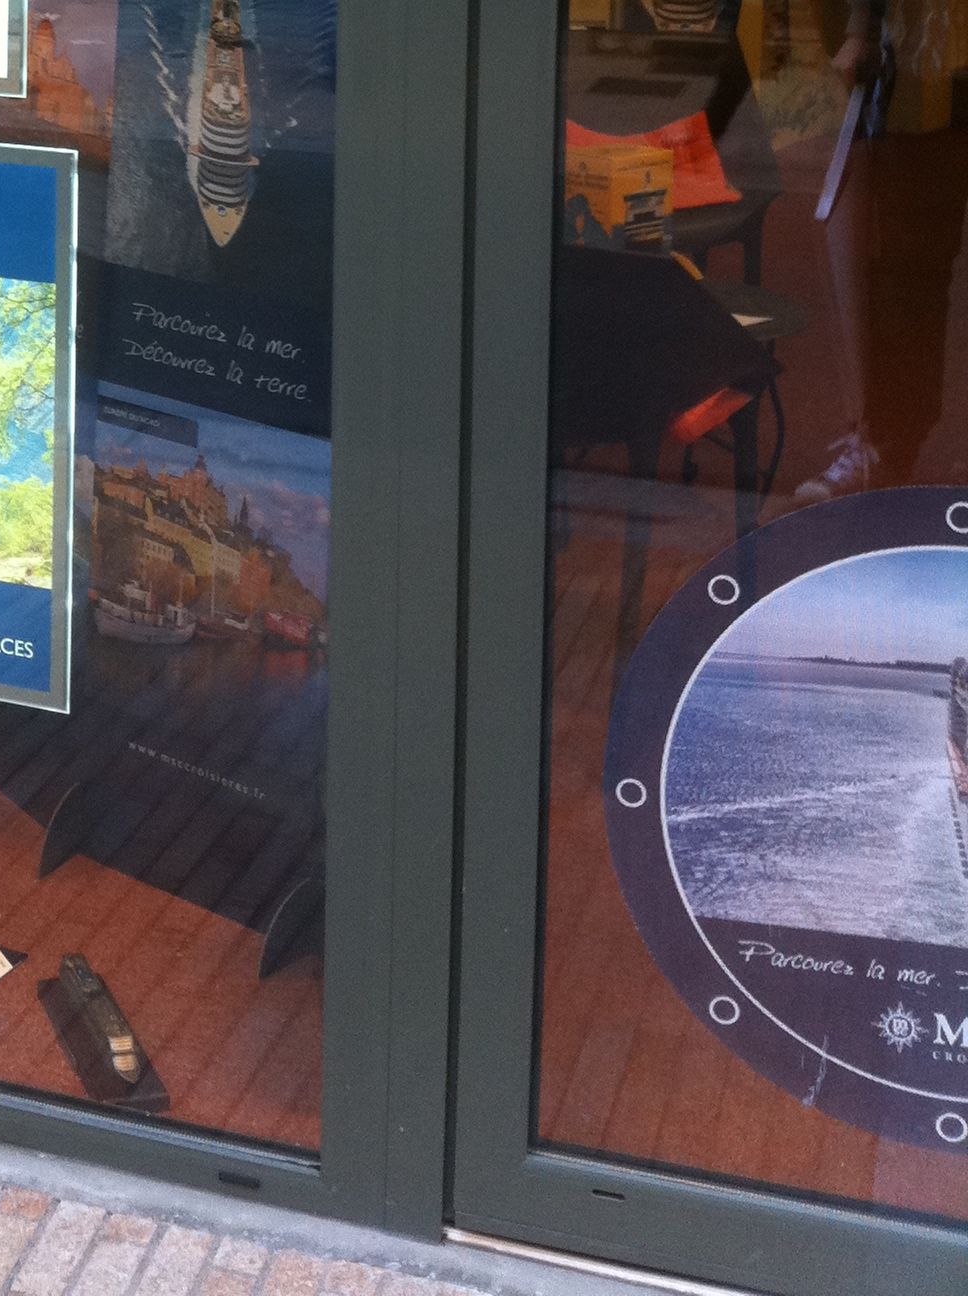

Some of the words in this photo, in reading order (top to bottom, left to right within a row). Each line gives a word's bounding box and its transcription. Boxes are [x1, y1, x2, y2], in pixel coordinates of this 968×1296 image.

[132, 302, 228, 343] Parcourez
[237, 326, 254, 351] la
[122, 338, 216, 376] Découvrez
[226, 360, 243, 385] la
[738, 939, 855, 976] Parcourez
[866, 958, 885, 981] la
